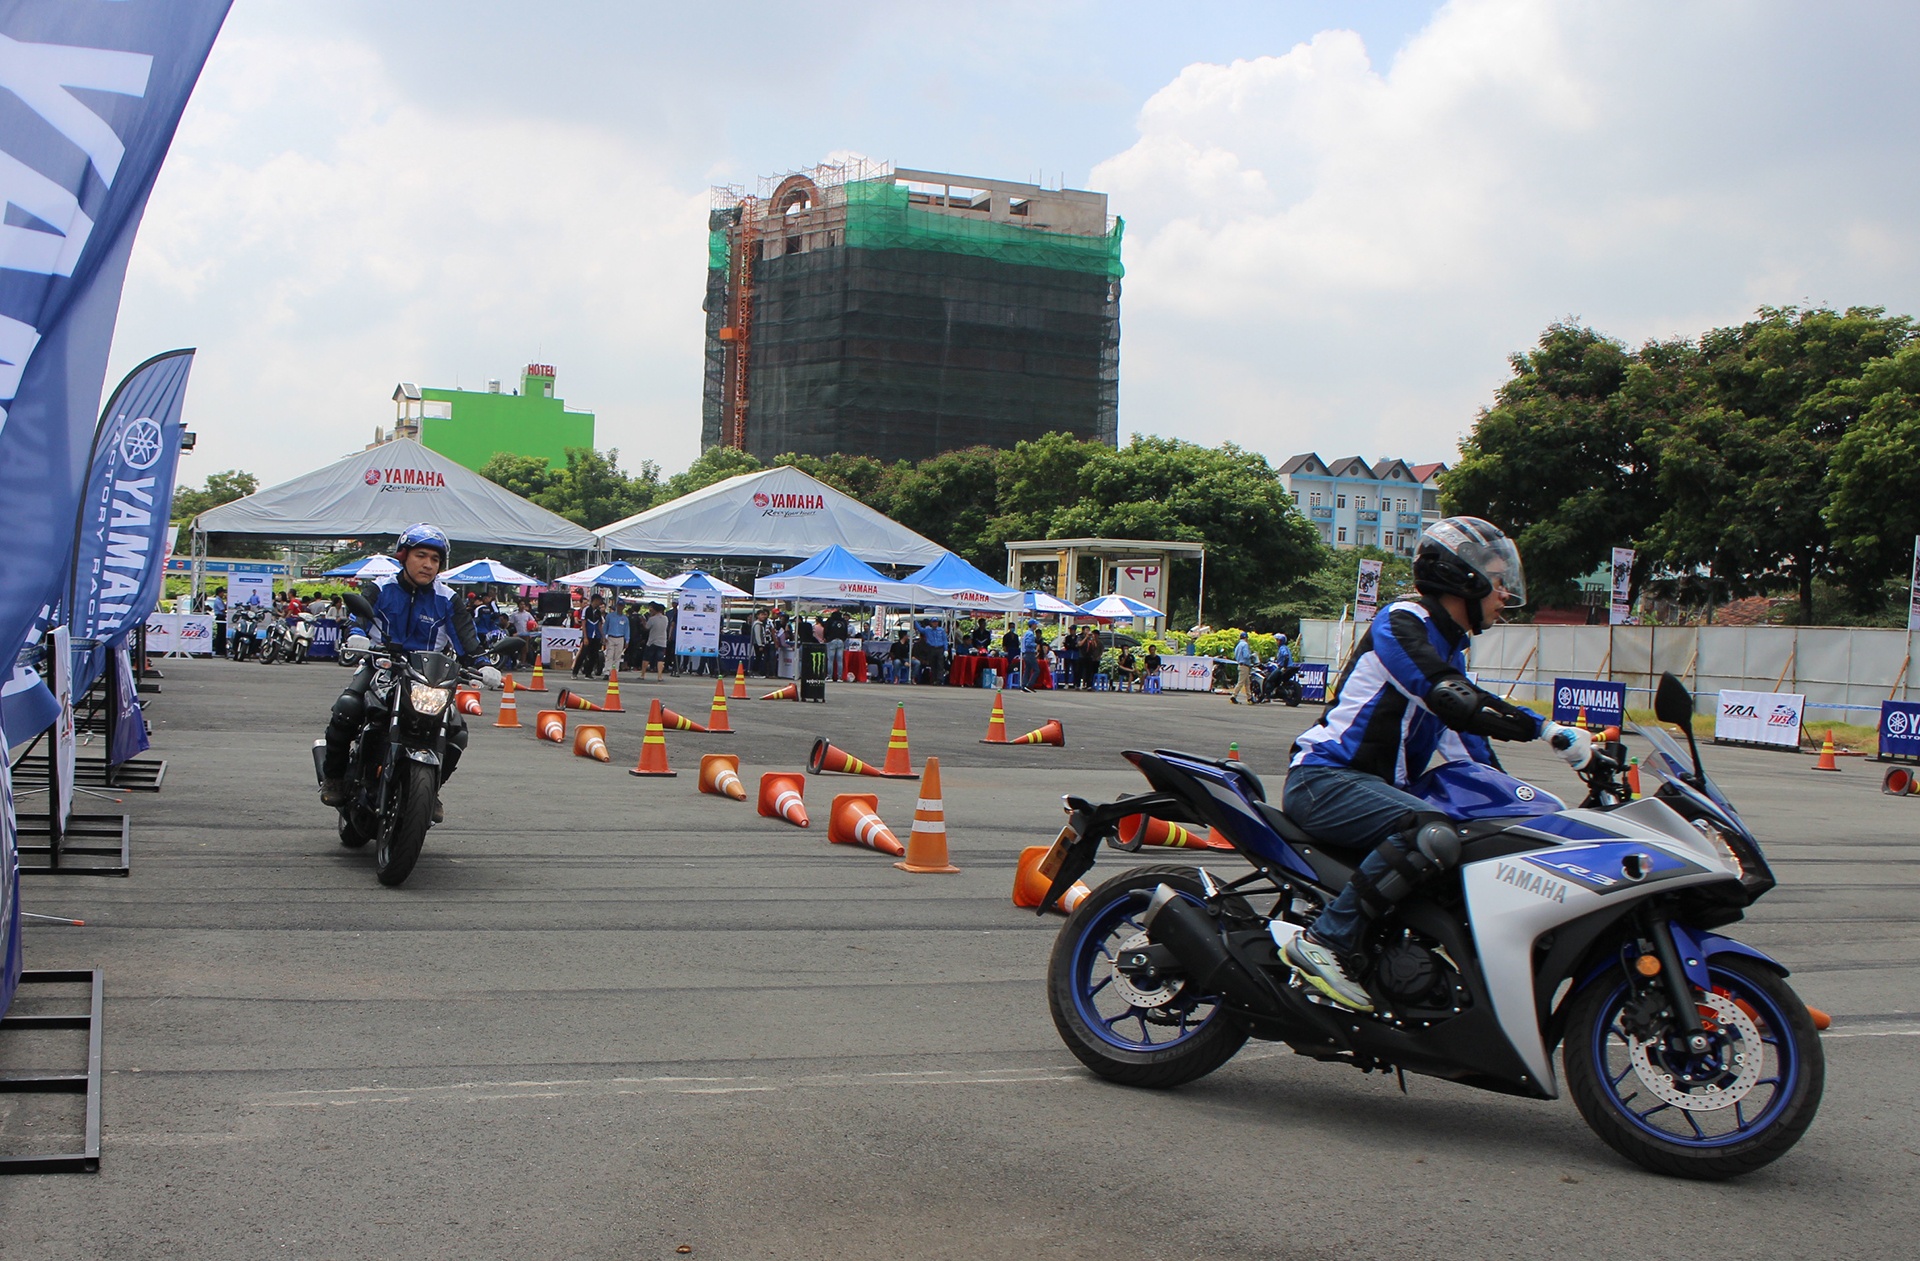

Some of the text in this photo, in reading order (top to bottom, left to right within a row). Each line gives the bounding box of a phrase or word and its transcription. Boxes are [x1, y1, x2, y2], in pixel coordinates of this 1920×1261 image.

[528, 363, 555, 377] HOTEL
[97, 414, 126, 542] FACTORY
[385, 468, 445, 487] YAMAHA
[771, 493, 824, 509] YAMAHA
[847, 584, 878, 594] YAMAHA
[960, 593, 990, 603] YAMAHA
[1572, 688, 1620, 709] YAMAHA
[1494, 862, 1569, 904] YAMAHA
